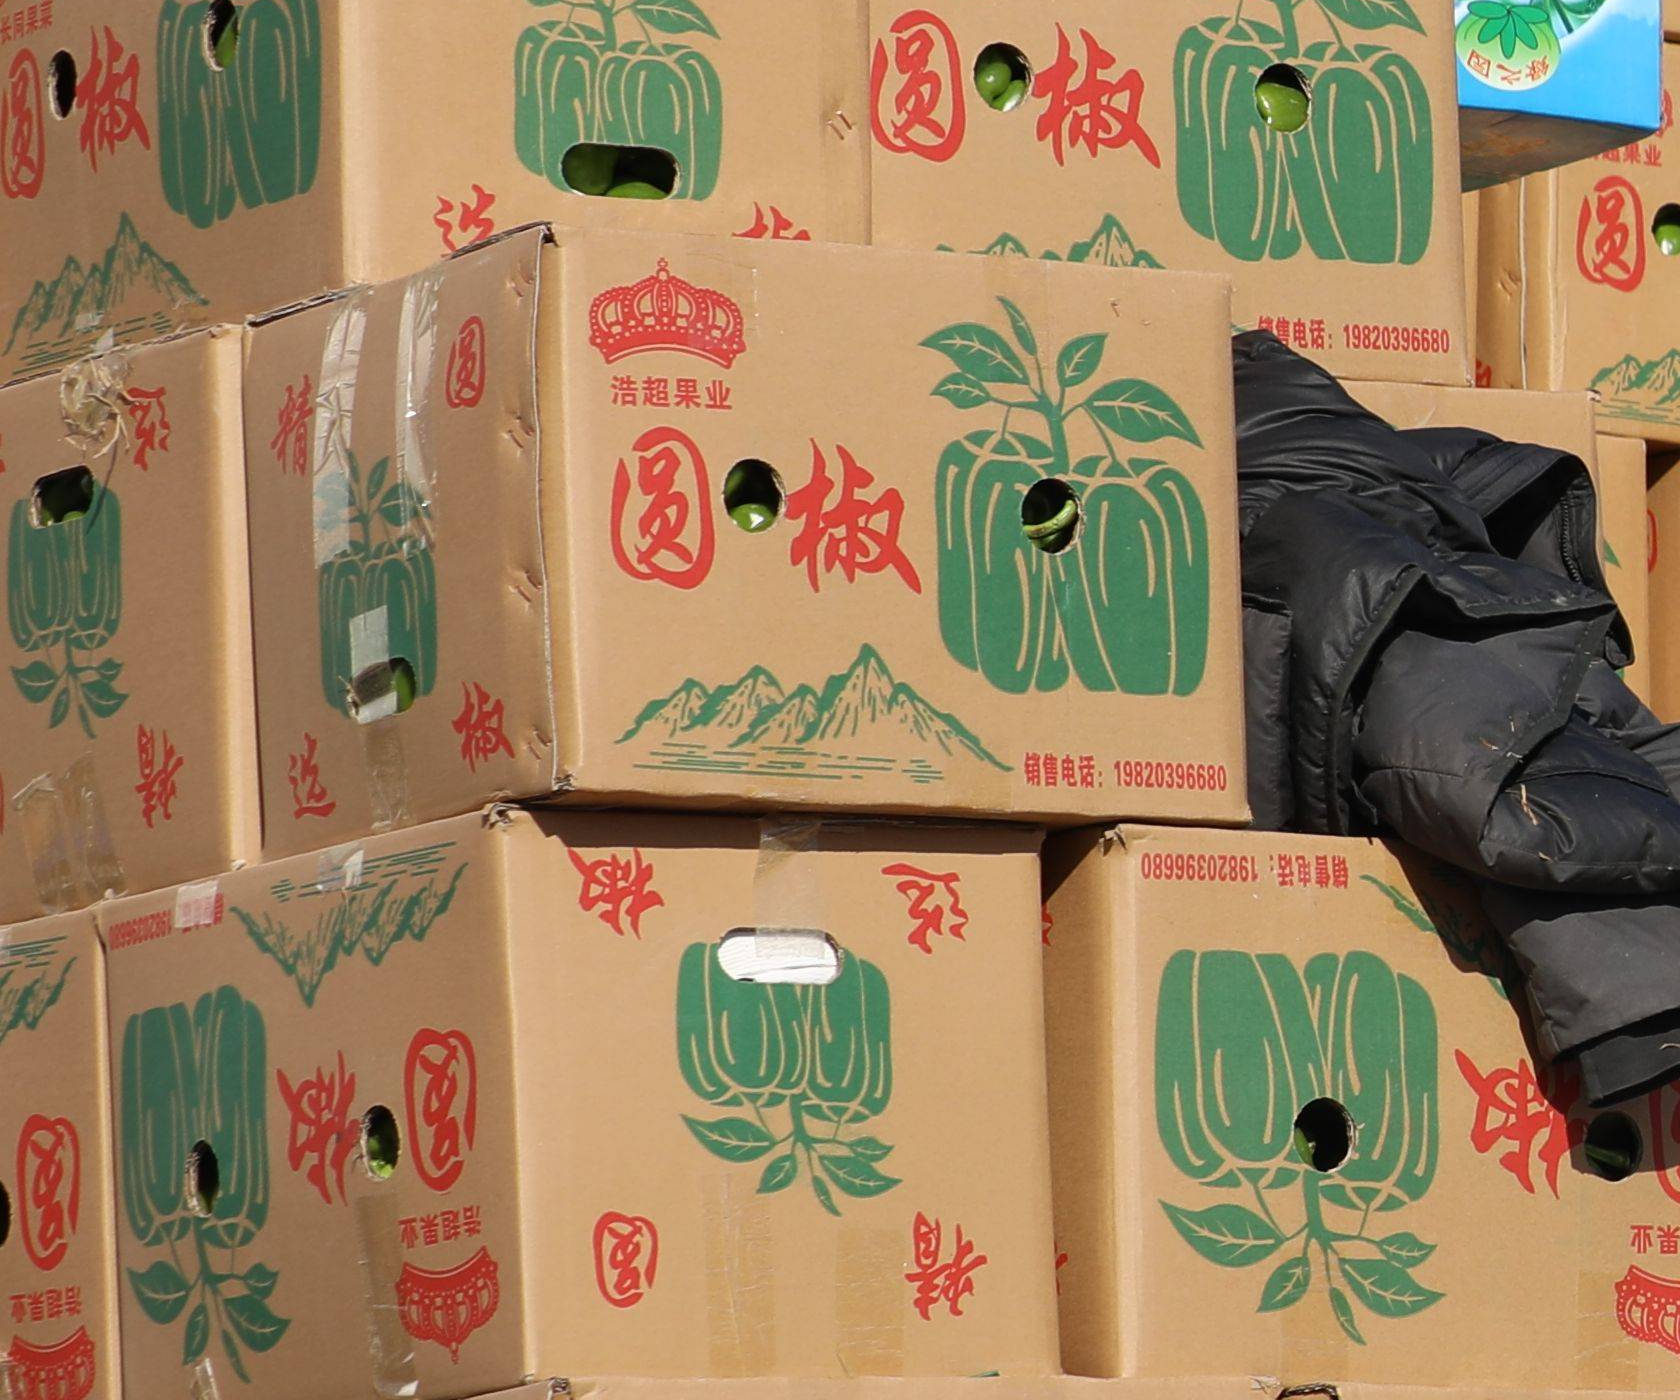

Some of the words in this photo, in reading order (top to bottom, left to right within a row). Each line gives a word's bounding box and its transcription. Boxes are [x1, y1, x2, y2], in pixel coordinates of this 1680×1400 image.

[0, 24, 152, 202] 圆椒
[869, 10, 1160, 168] 圆椒
[1466, 48, 1551, 87] 绿之园
[1603, 143, 1660, 166] 超果业
[445, 316, 486, 408] 圆
[611, 376, 730, 409] 浩超果业
[271, 376, 313, 475] 精
[611, 427, 921, 594] 圆椒
[452, 682, 515, 772] 椒
[134, 725, 185, 828] 精
[288, 733, 336, 819] 选
[561, 837, 664, 935] 椒
[881, 863, 968, 954] 选
[277, 1028, 477, 1205] 圆椒
[16, 1114, 81, 1271] 圆
[398, 1206, 481, 1248] 浩超果业
[593, 1212, 658, 1308] 圆
[905, 1212, 987, 1320] 精
